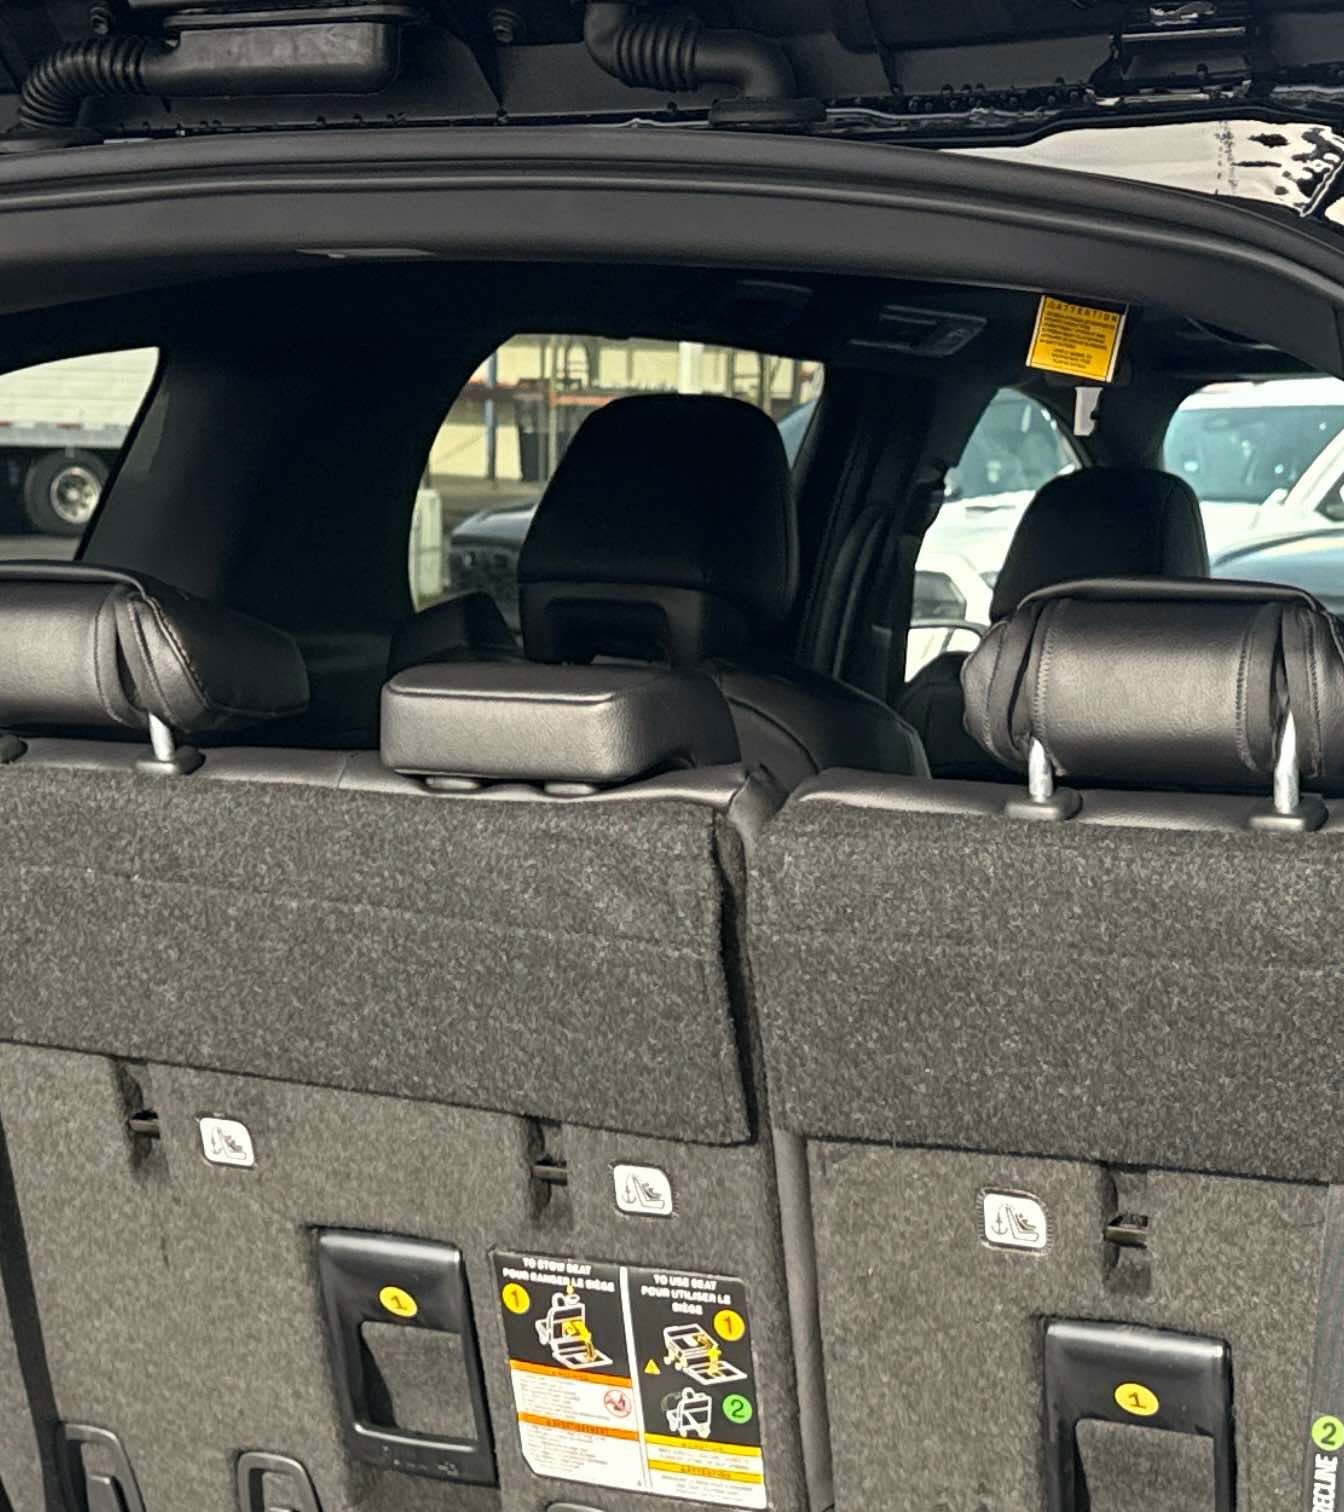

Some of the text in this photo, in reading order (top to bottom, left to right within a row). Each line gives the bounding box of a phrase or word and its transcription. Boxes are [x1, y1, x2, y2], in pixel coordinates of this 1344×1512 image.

[522, 1257, 536, 1268] TO
[653, 1274, 669, 1286] TO
[730, 1399, 745, 1418] 2
[1319, 1421, 1338, 1446] 2
